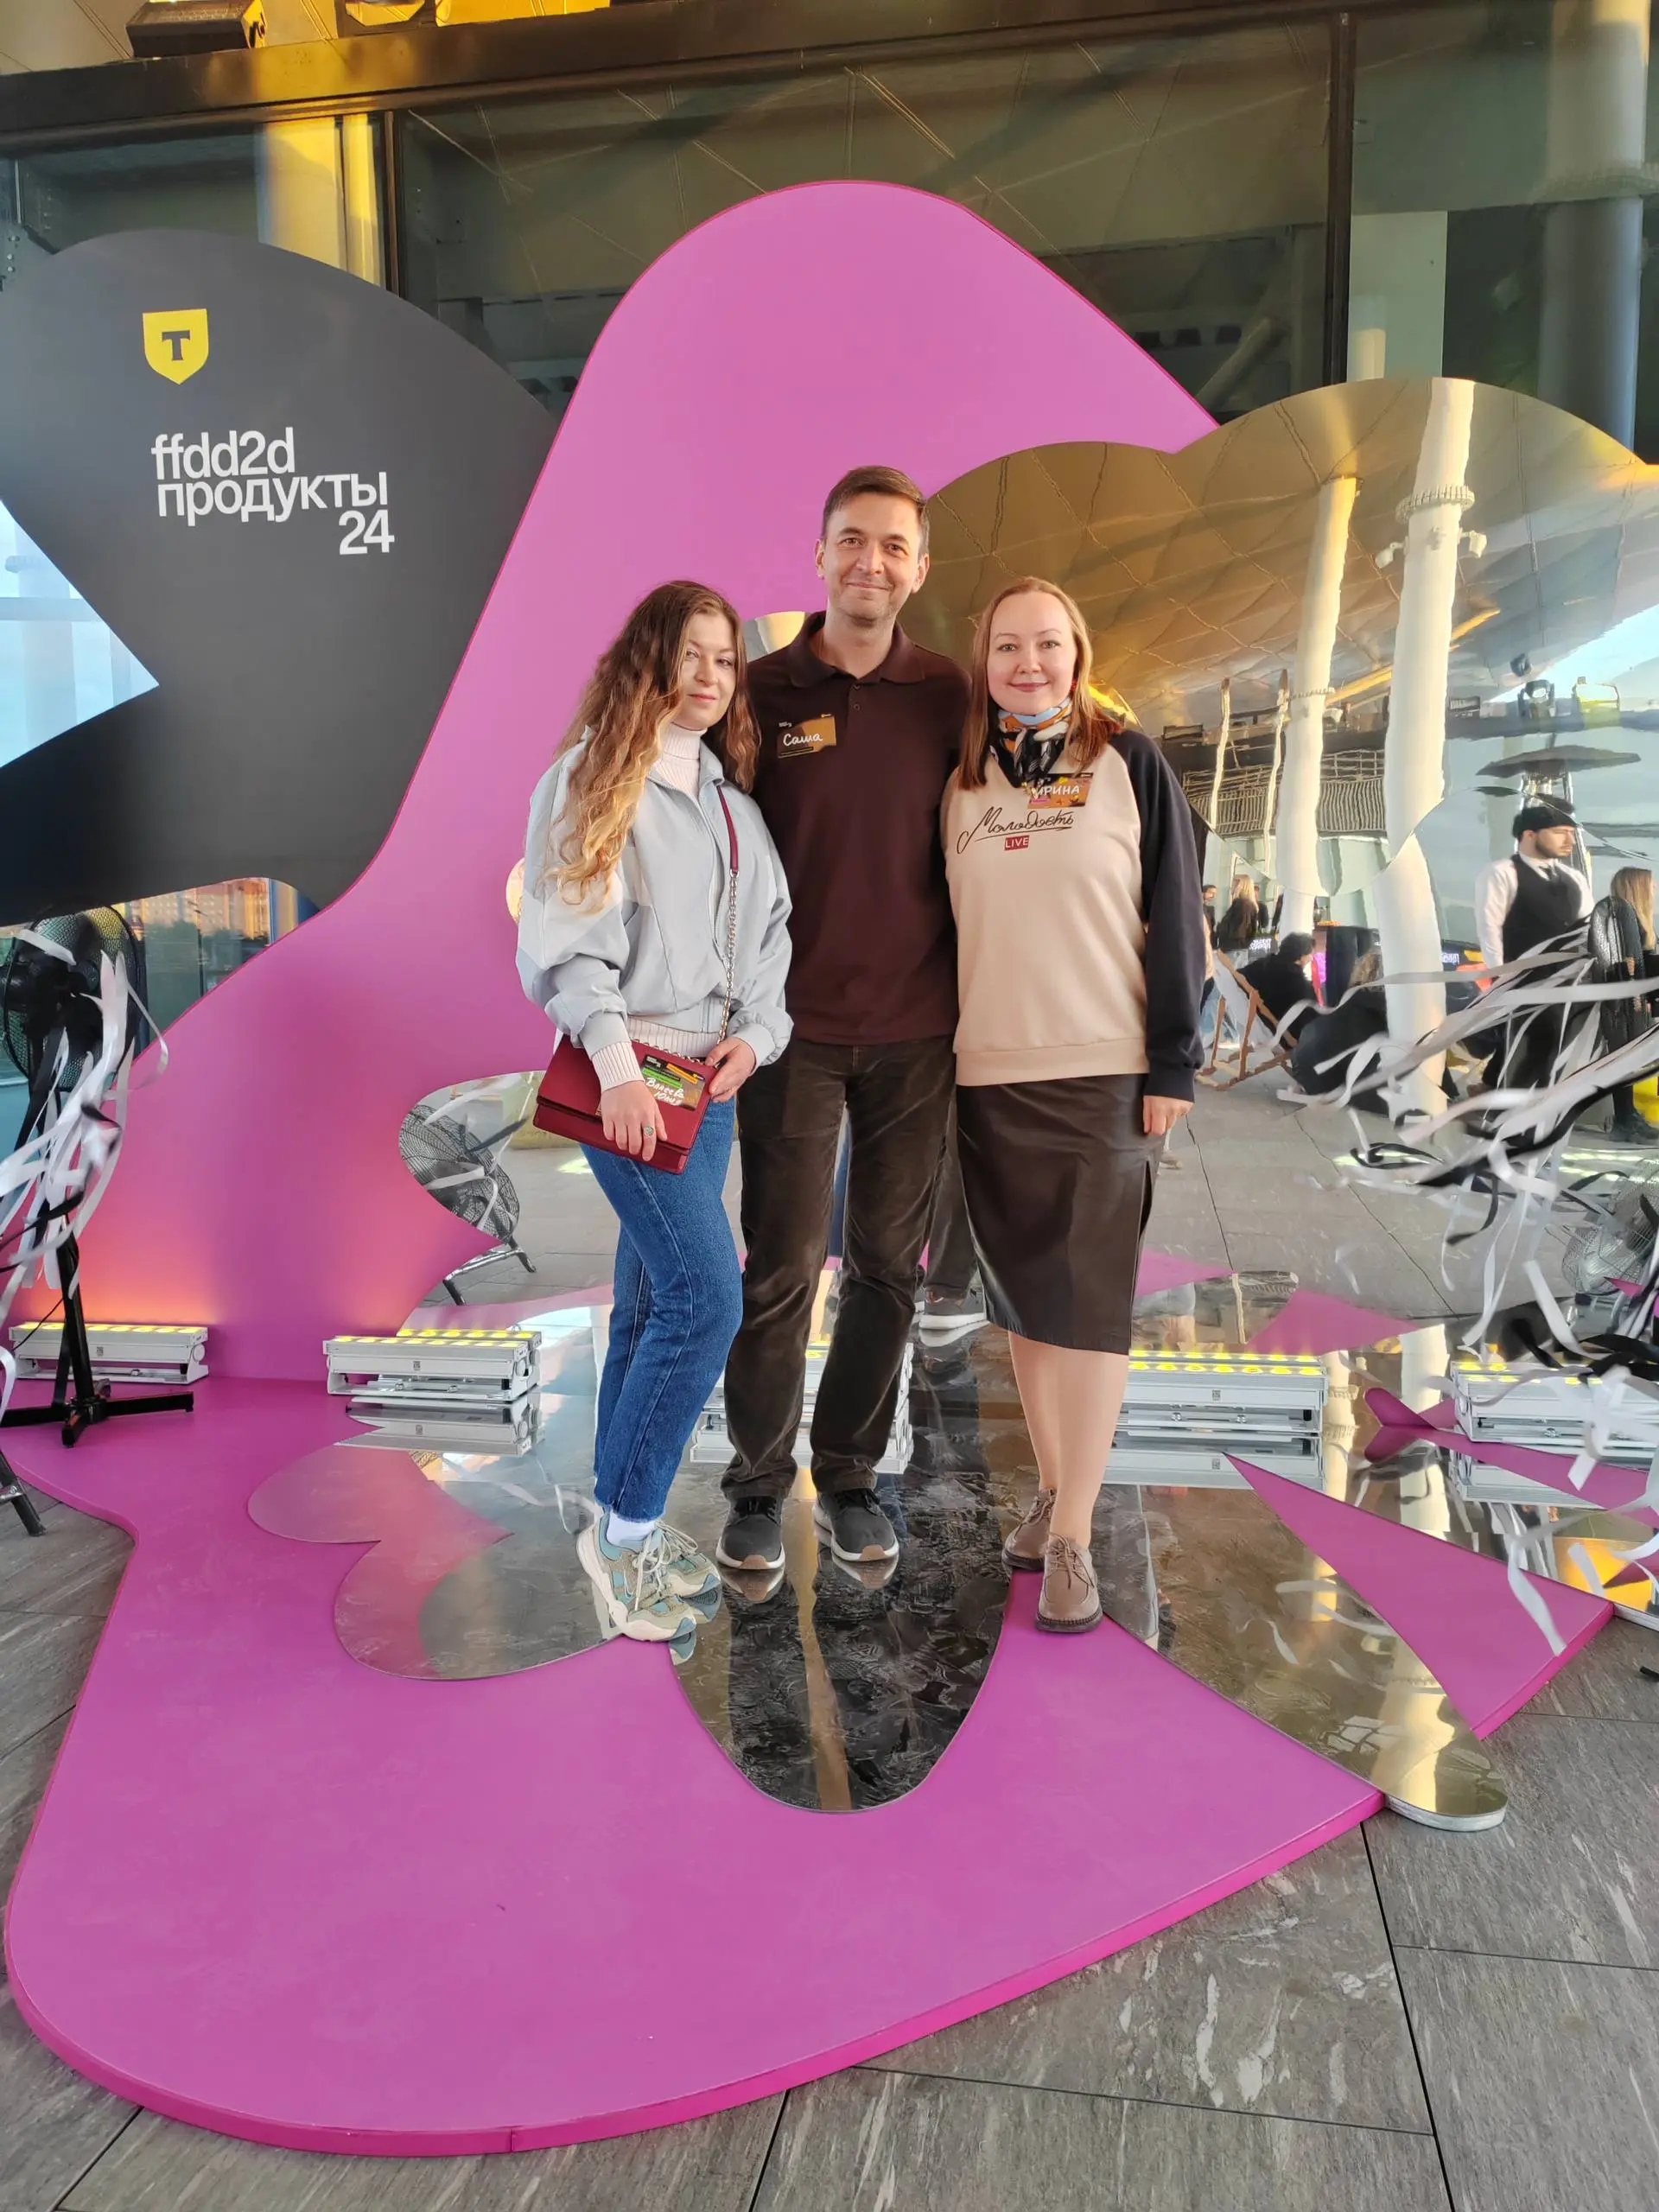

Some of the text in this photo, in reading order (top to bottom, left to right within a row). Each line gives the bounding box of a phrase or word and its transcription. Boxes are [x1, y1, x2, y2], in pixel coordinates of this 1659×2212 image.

[150, 427, 296, 480] ffdd2d
[157, 472, 388, 527] продукты
[338, 509, 396, 555] 24
[783, 733, 823, 747] Саша
[1005, 836, 1030, 849] LIVE
